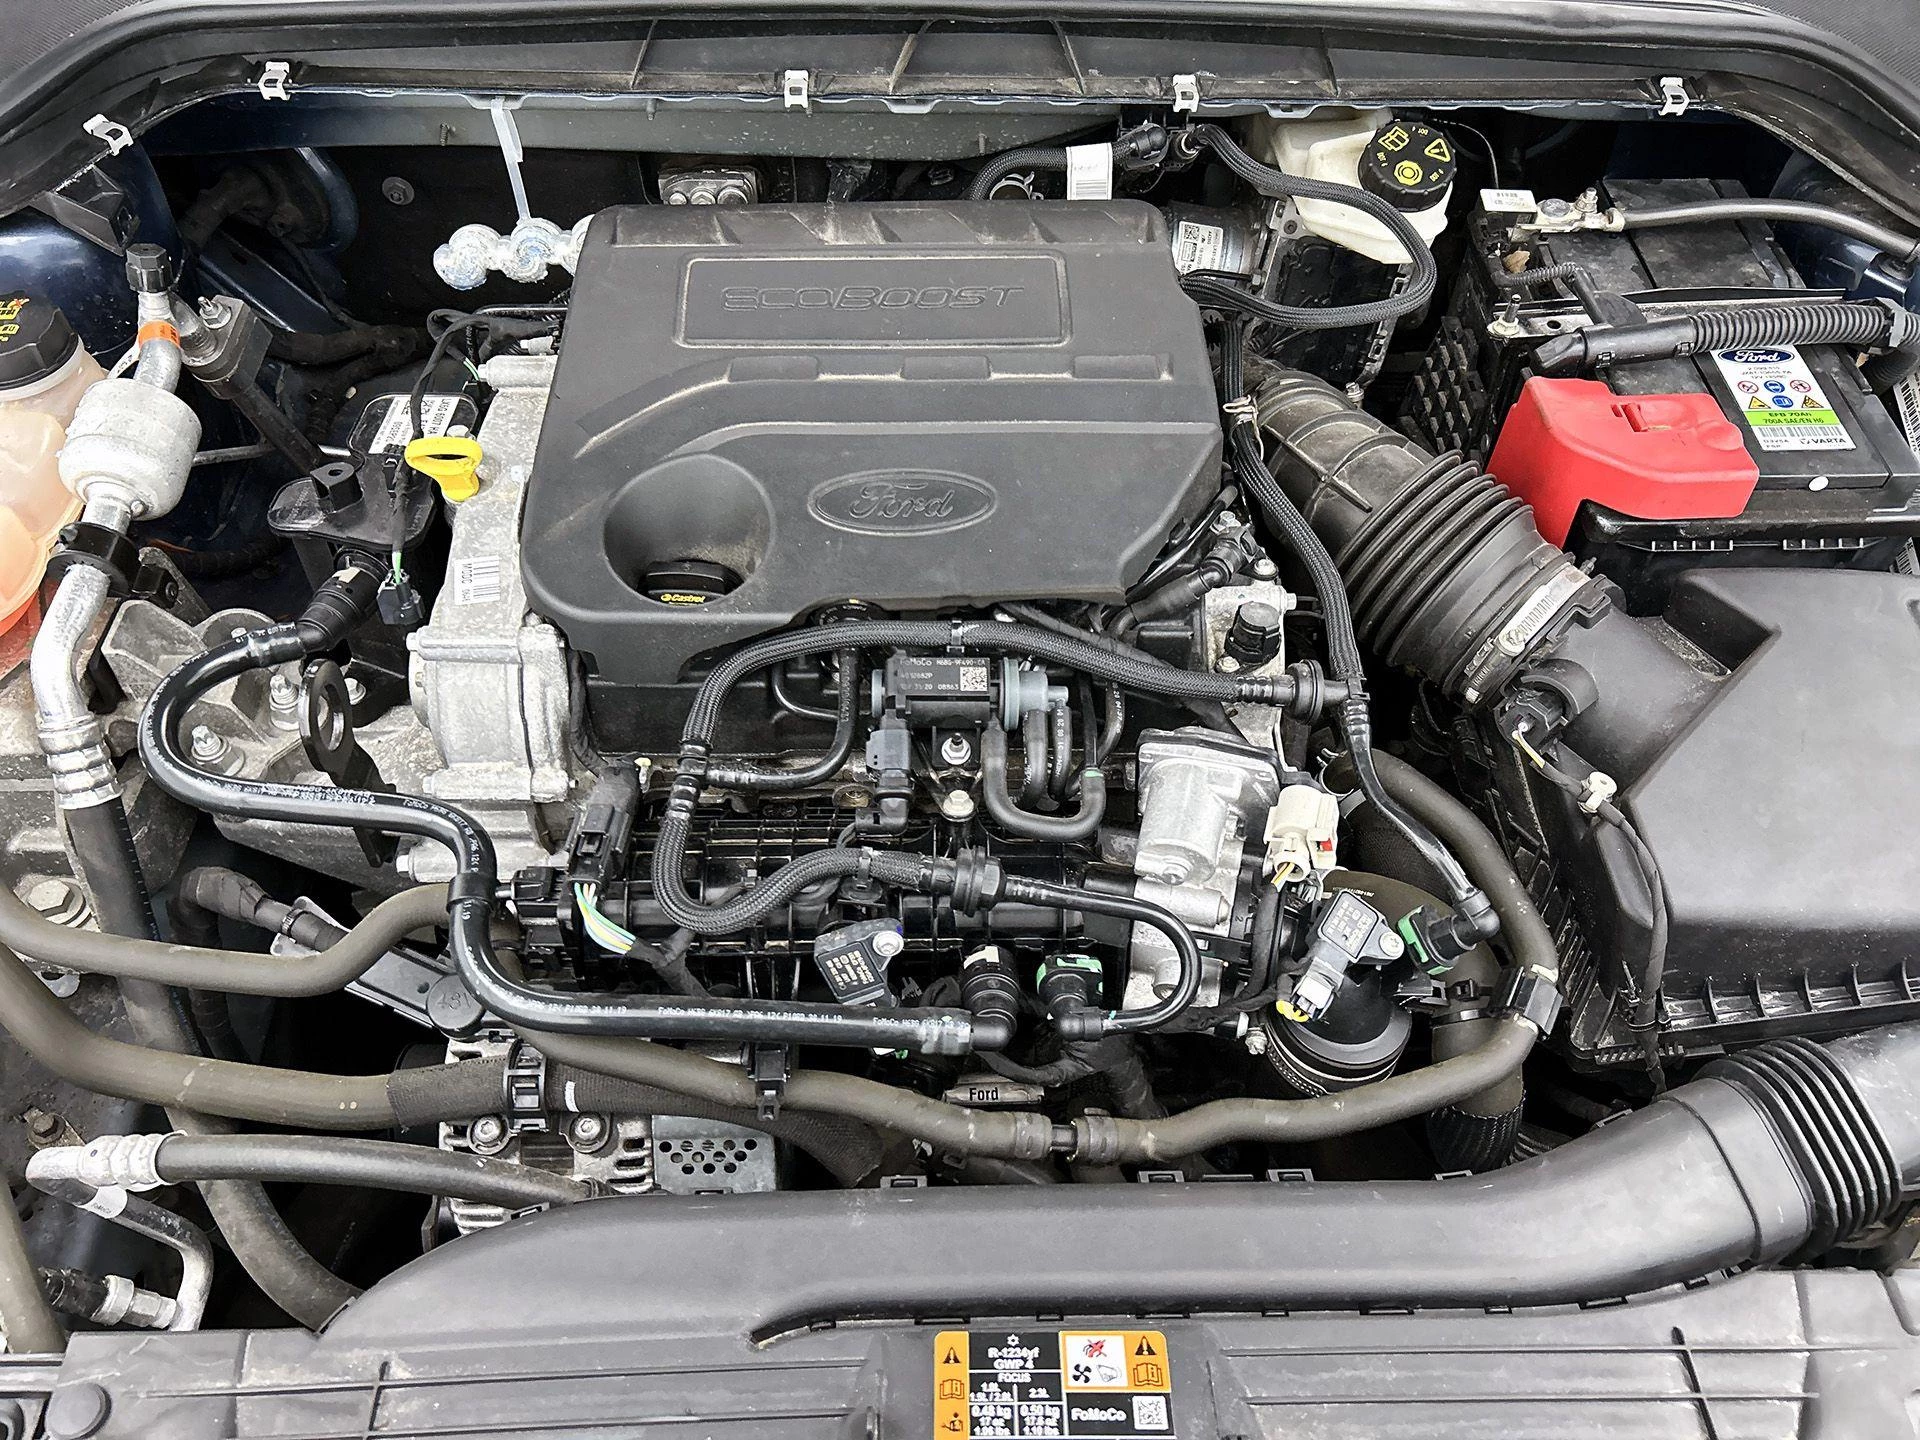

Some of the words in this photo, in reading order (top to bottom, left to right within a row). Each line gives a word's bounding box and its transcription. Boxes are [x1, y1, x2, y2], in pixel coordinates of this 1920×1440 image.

[721, 286, 1025, 311] ECOBOOST
[1734, 349, 1781, 363] Ford
[850, 481, 956, 518] Ford
[671, 594, 706, 603] Castrol
[969, 1087, 999, 1101] Ford
[988, 1347, 1040, 1359] R-1234yf
[993, 1358, 1024, 1370] GWP
[1025, 1359, 1035, 1369] 4
[998, 1372, 1032, 1383] FOCUS
[996, 1405, 1012, 1420] kg
[1045, 1405, 1060, 1420] kg
[1071, 1407, 1127, 1421] FoMoCo
